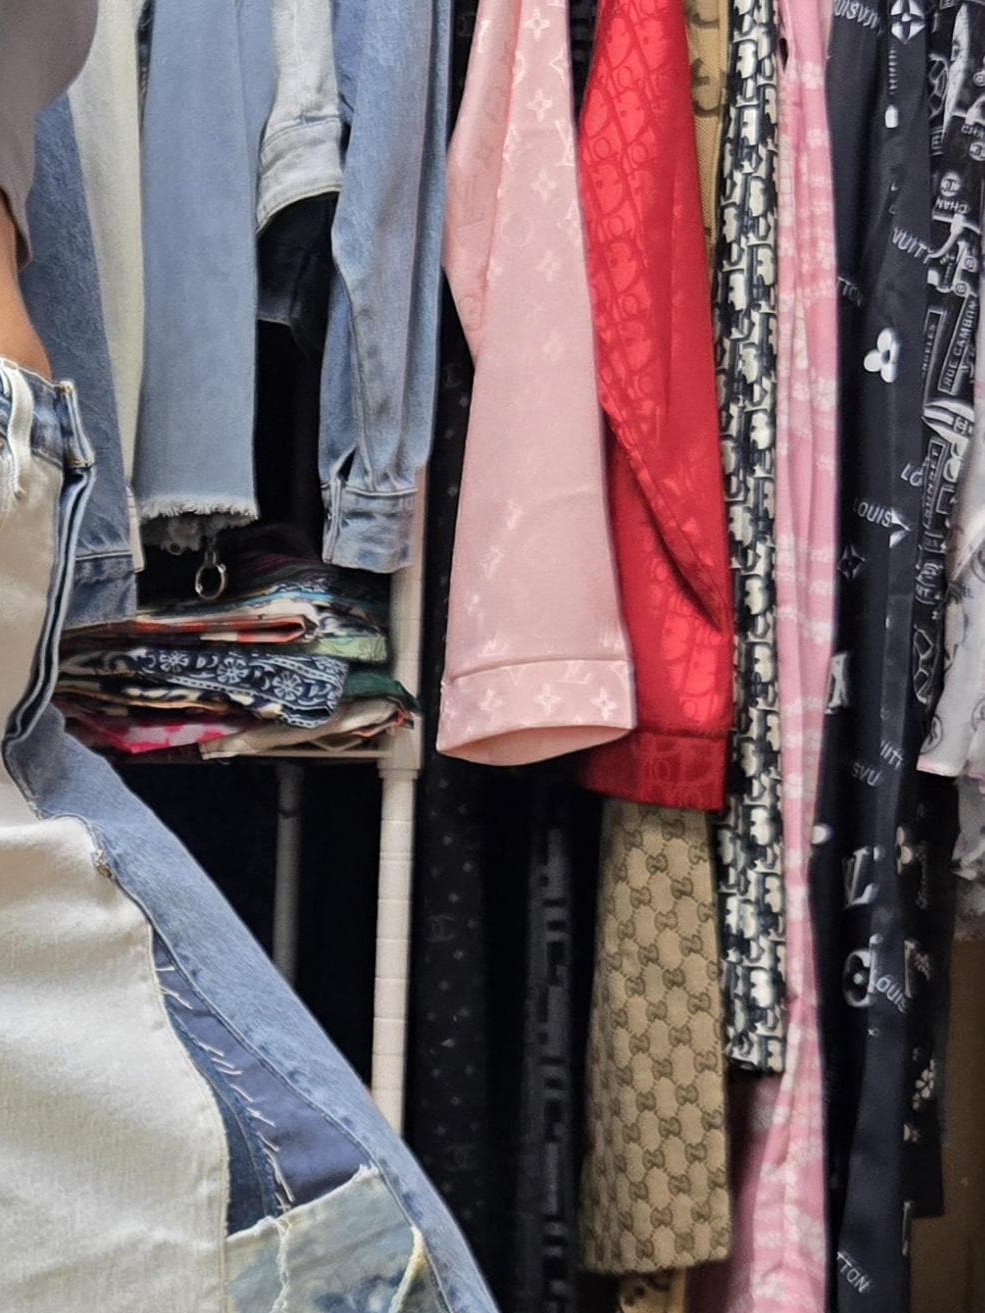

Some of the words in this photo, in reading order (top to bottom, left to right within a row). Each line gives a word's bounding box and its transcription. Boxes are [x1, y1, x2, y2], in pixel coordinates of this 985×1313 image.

[943, 359, 958, 386] RUE
[954, 300, 978, 356] CAMBON
[855, 501, 892, 527] OUIS
